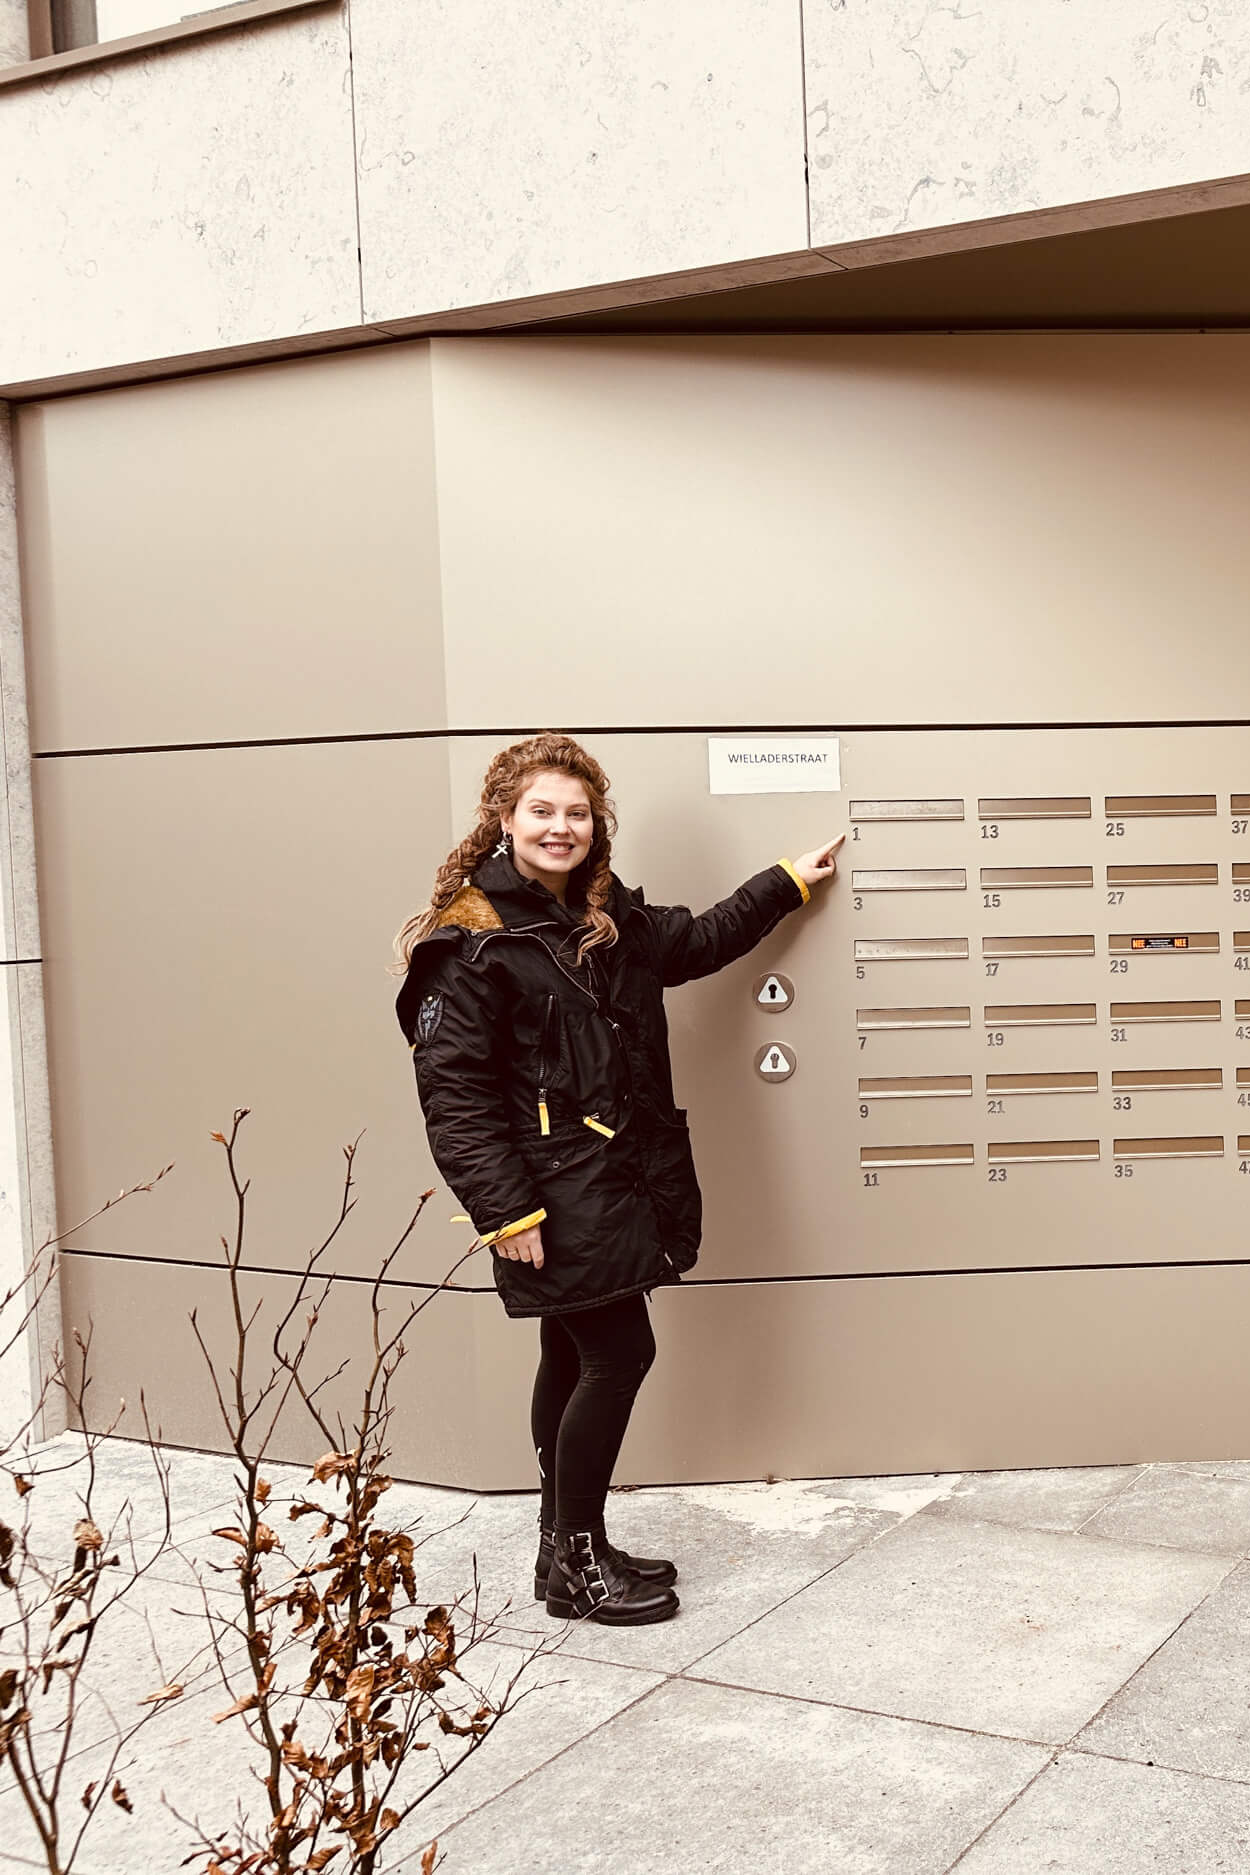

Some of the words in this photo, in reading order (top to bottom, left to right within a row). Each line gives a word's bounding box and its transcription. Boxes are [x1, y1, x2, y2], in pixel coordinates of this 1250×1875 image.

[728, 752, 828, 764] WIELLADERSTRAAT
[852, 827, 861, 841] 1
[980, 824, 1000, 839] 13
[1105, 822, 1125, 837] 25
[1231, 819, 1249, 835] 37
[853, 896, 863, 911] 3
[983, 893, 1001, 909] 15
[1107, 891, 1125, 905] 27
[985, 962, 1000, 977] 17
[1109, 959, 1129, 974] 29
[1233, 956, 1250, 971] 41
[855, 965, 866, 980] 5
[987, 1032, 1004, 1047] 19
[1110, 1028, 1128, 1042] 31
[857, 1036, 867, 1051] 7
[987, 1100, 1004, 1114] 21
[1112, 1096, 1132, 1111] 33
[859, 1104, 869, 1119] 9
[988, 1168, 1008, 1182] 23
[1114, 1164, 1134, 1178] 35
[863, 1172, 880, 1187] 11
